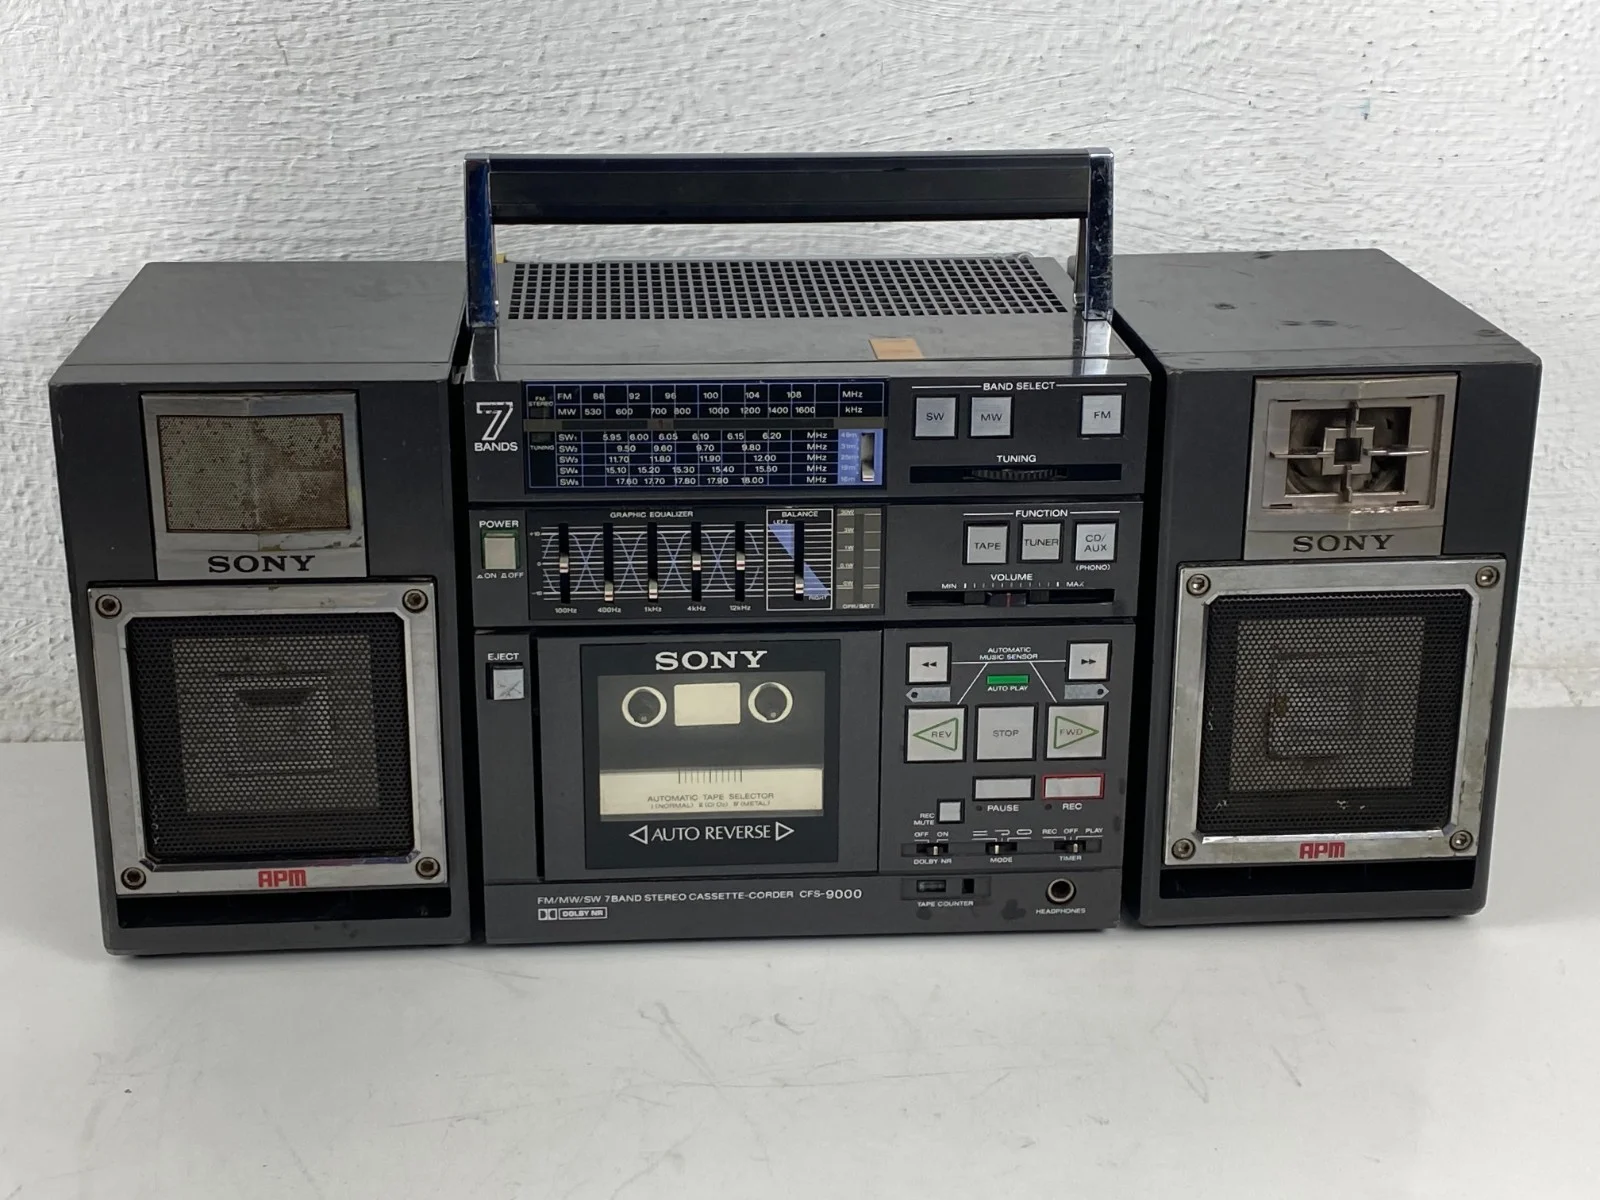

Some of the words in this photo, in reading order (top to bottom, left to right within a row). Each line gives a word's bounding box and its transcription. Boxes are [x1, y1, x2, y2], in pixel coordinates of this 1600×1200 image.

[983, 382, 1013, 391] BAND
[1016, 381, 1055, 390] SELECT
[628, 392, 641, 400] 92
[664, 392, 677, 400] 96
[786, 391, 802, 399] 108
[842, 390, 863, 398] MHz
[708, 407, 730, 415] 1000
[768, 406, 789, 414] 1400
[795, 406, 815, 414] 1600
[1093, 411, 1111, 419] FM
[926, 412, 945, 421] SW
[980, 413, 1003, 422] MW
[476, 402, 514, 441] 7
[629, 433, 649, 441] 6.00
[658, 433, 678, 441] 6.05
[727, 432, 744, 440] 6.15
[762, 432, 782, 440] 6.20
[474, 442, 518, 452] BANDS
[696, 444, 715, 452] 9.70
[741, 443, 761, 451] 9.80
[650, 455, 672, 463] 11.80
[753, 454, 776, 462] 12.00
[996, 454, 1037, 463] TUNING
[637, 466, 660, 474] 15.20
[672, 466, 695, 474] 15.30
[711, 465, 735, 473] 15.40
[755, 465, 778, 473] 15.50
[674, 477, 696, 485] 17.80
[741, 476, 764, 484] 18.00
[1015, 509, 1068, 518] FUNCTION
[479, 520, 519, 529] POWER
[1024, 538, 1059, 547] TUNER
[1085, 534, 1106, 543] CD/
[1293, 534, 1394, 552] SONY
[974, 542, 1001, 550] TAPE
[1084, 544, 1107, 552] AUX
[207, 555, 316, 573] SONY
[990, 573, 1033, 582] VOLUME
[487, 653, 519, 661] EJECT
[655, 650, 768, 671] SONY
[931, 730, 952, 738] REV
[993, 729, 1019, 737] STOP
[1059, 728, 1083, 736] FWD
[647, 794, 698, 802] AUTOMATIC
[703, 793, 724, 801] TAPE
[987, 804, 1020, 812] PAUSE
[1062, 803, 1082, 811] REC
[651, 827, 700, 842] AUTO
[705, 825, 771, 840] REVERSE
[1299, 842, 1346, 859] APM
[257, 868, 307, 888] APM
[537, 896, 601, 905] FM/MW/SW
[644, 893, 687, 902] STEREO
[688, 890, 794, 900] CASSETTE-CORDER
[799, 889, 862, 899] CFS-9000
